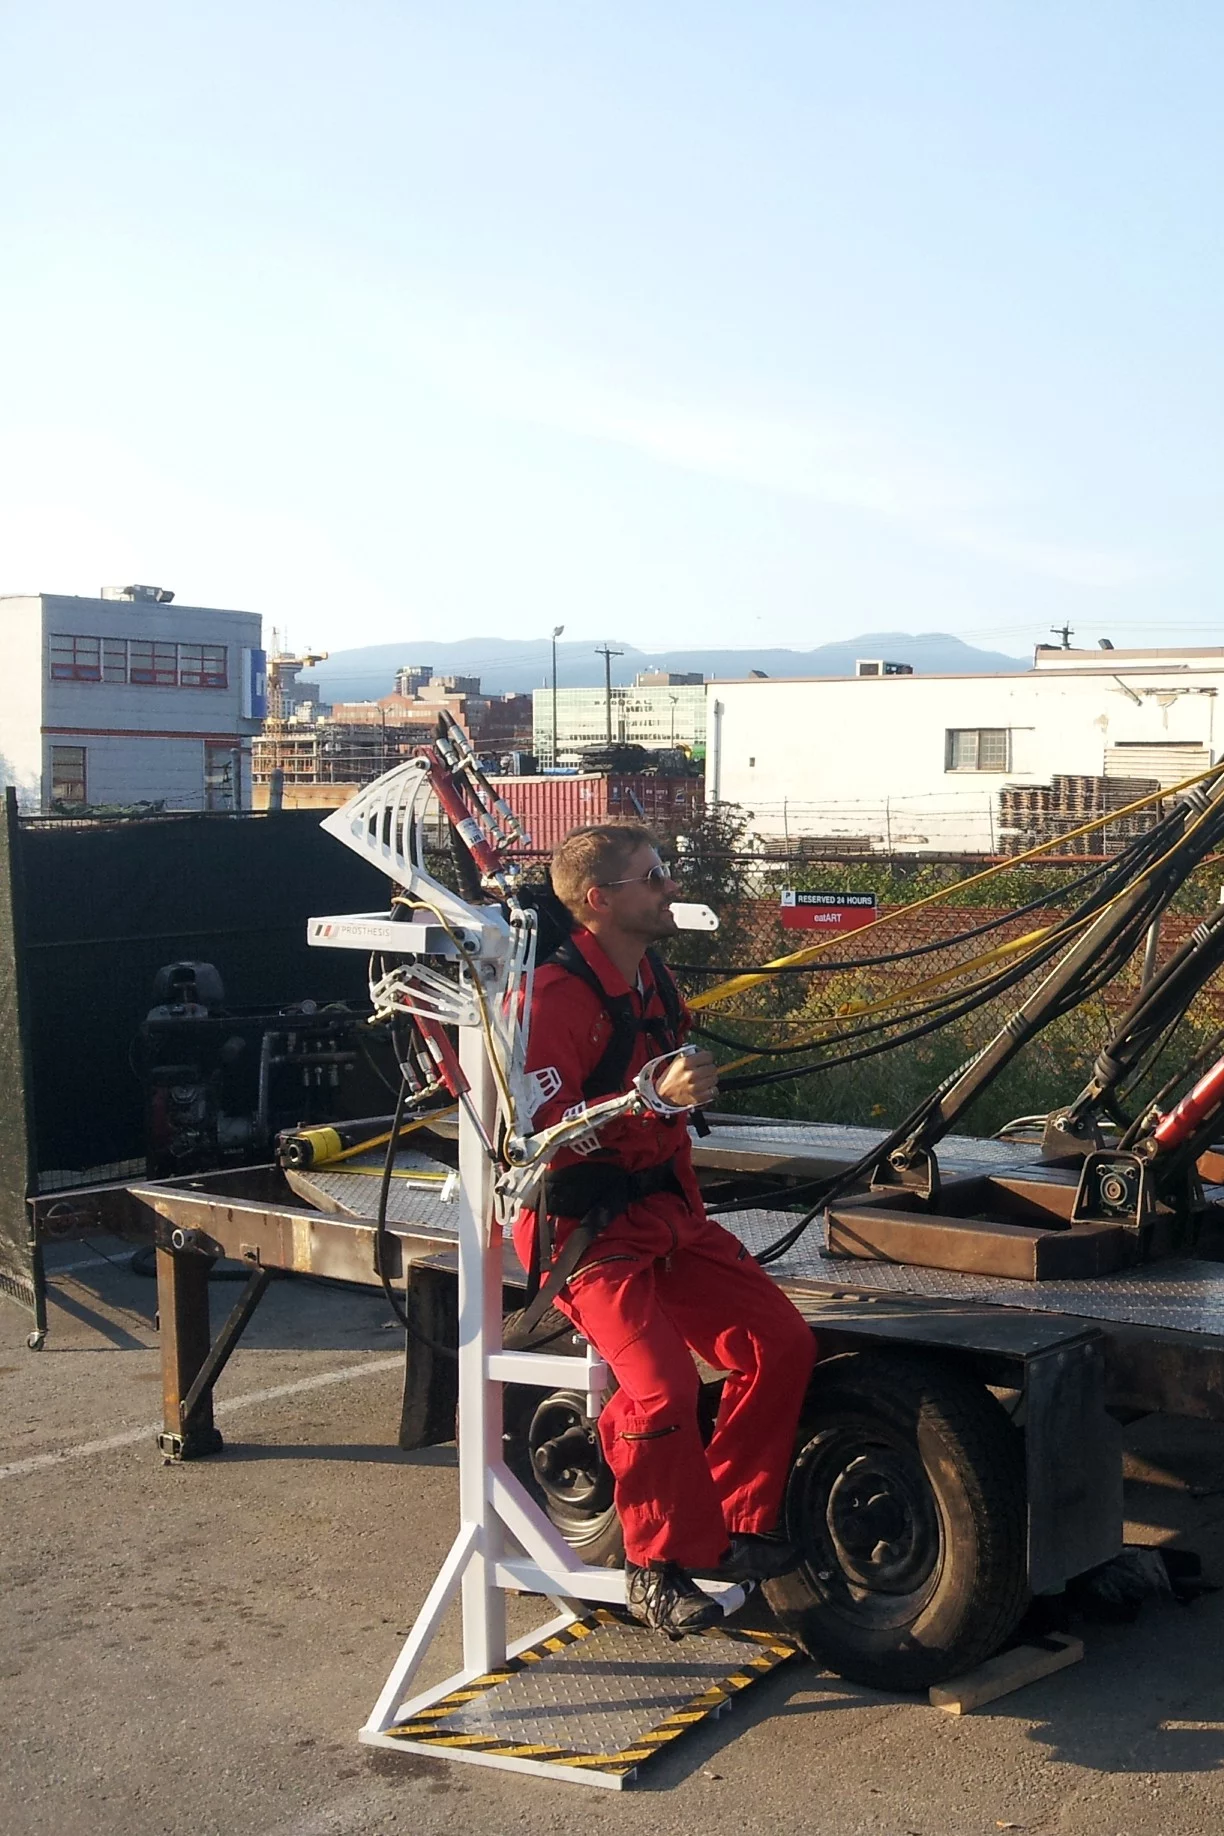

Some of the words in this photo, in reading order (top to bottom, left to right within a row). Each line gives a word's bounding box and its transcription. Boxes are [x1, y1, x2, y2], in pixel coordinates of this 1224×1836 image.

[798, 895, 836, 904] RESERVED
[837, 896, 845, 904] 24
[847, 896, 873, 905] HOURS
[814, 913, 842, 923] eatART
[341, 925, 391, 937] PROSTHESIS
